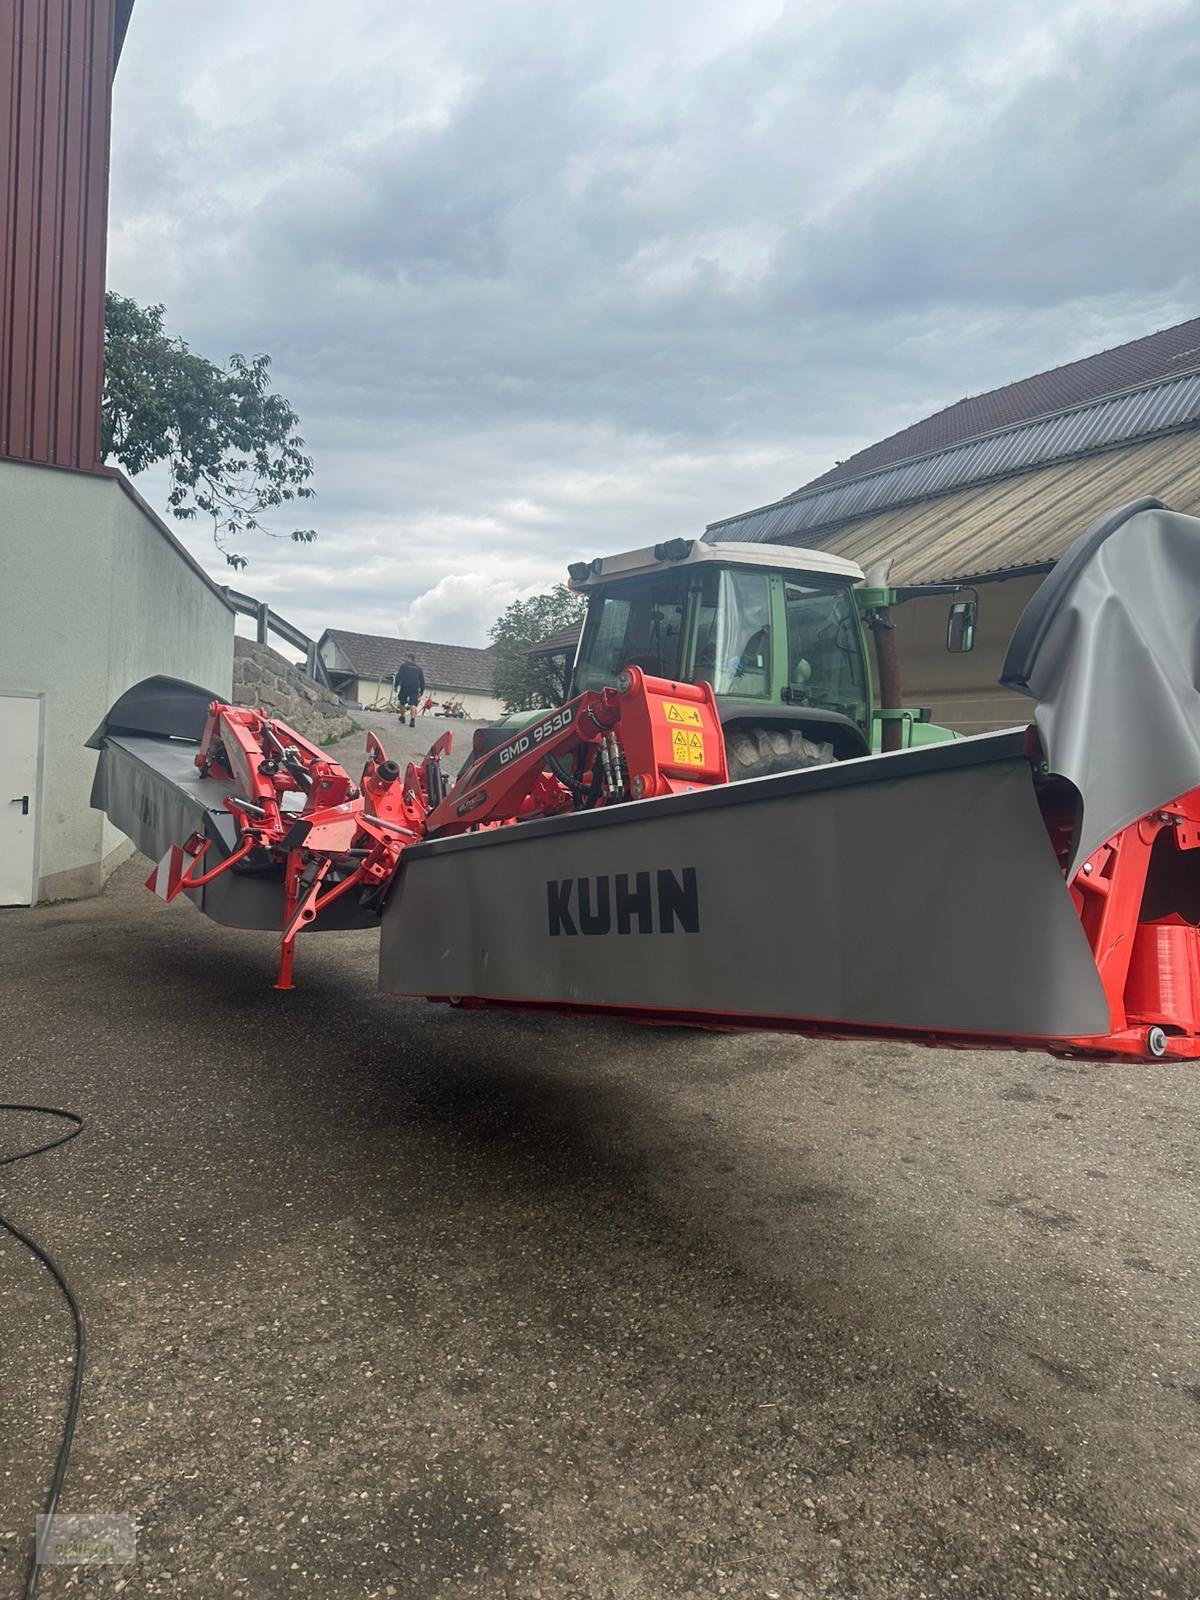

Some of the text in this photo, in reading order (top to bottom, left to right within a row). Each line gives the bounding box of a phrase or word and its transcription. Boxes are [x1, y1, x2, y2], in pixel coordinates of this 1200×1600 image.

[499, 709, 572, 765] GMD 9530
[547, 867, 699, 936] KUHN
